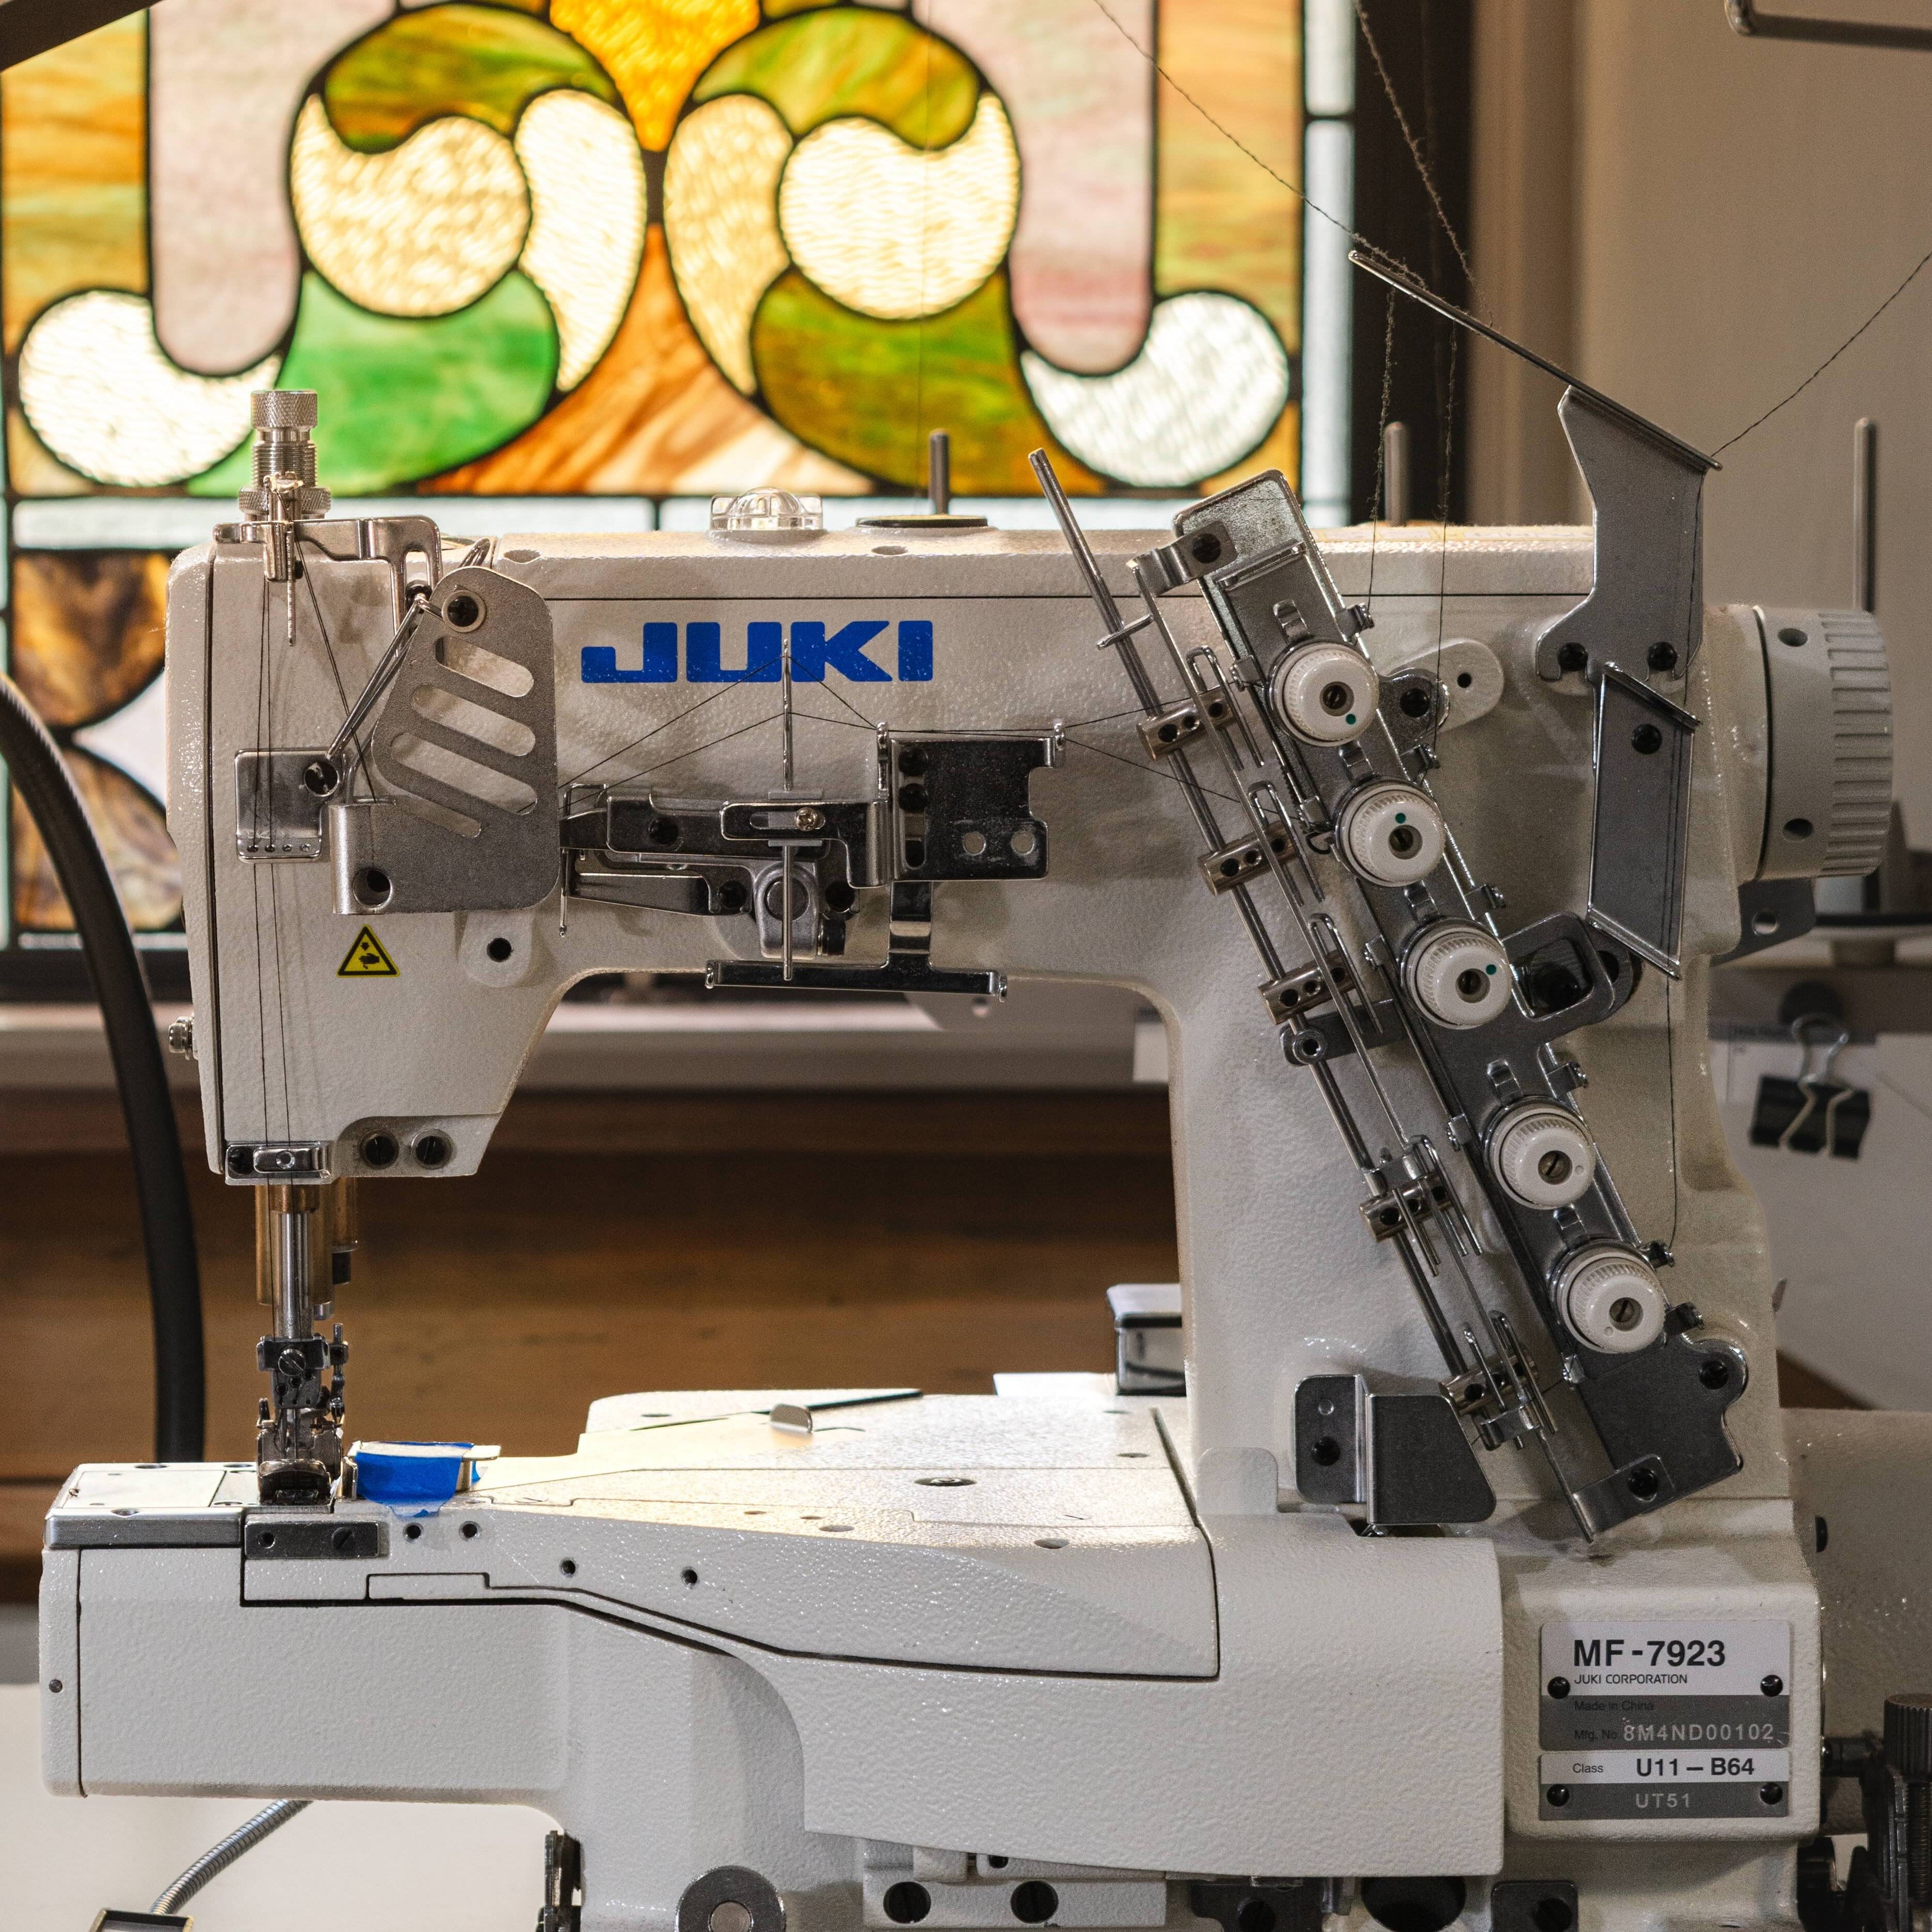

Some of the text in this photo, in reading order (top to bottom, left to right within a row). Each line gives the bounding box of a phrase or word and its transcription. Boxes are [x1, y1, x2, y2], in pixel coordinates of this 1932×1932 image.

[581, 621, 933, 682] JUKI
[1574, 1640, 1725, 1666] MF-7923
[1574, 1674, 1687, 1684] JUKI CORPORATION
[1574, 1700, 1654, 1711] Made in China
[1624, 1724, 1773, 1741] 8M4ND00102
[1572, 1763, 1603, 1774] Class
[1635, 1793, 1690, 1808] UT51
